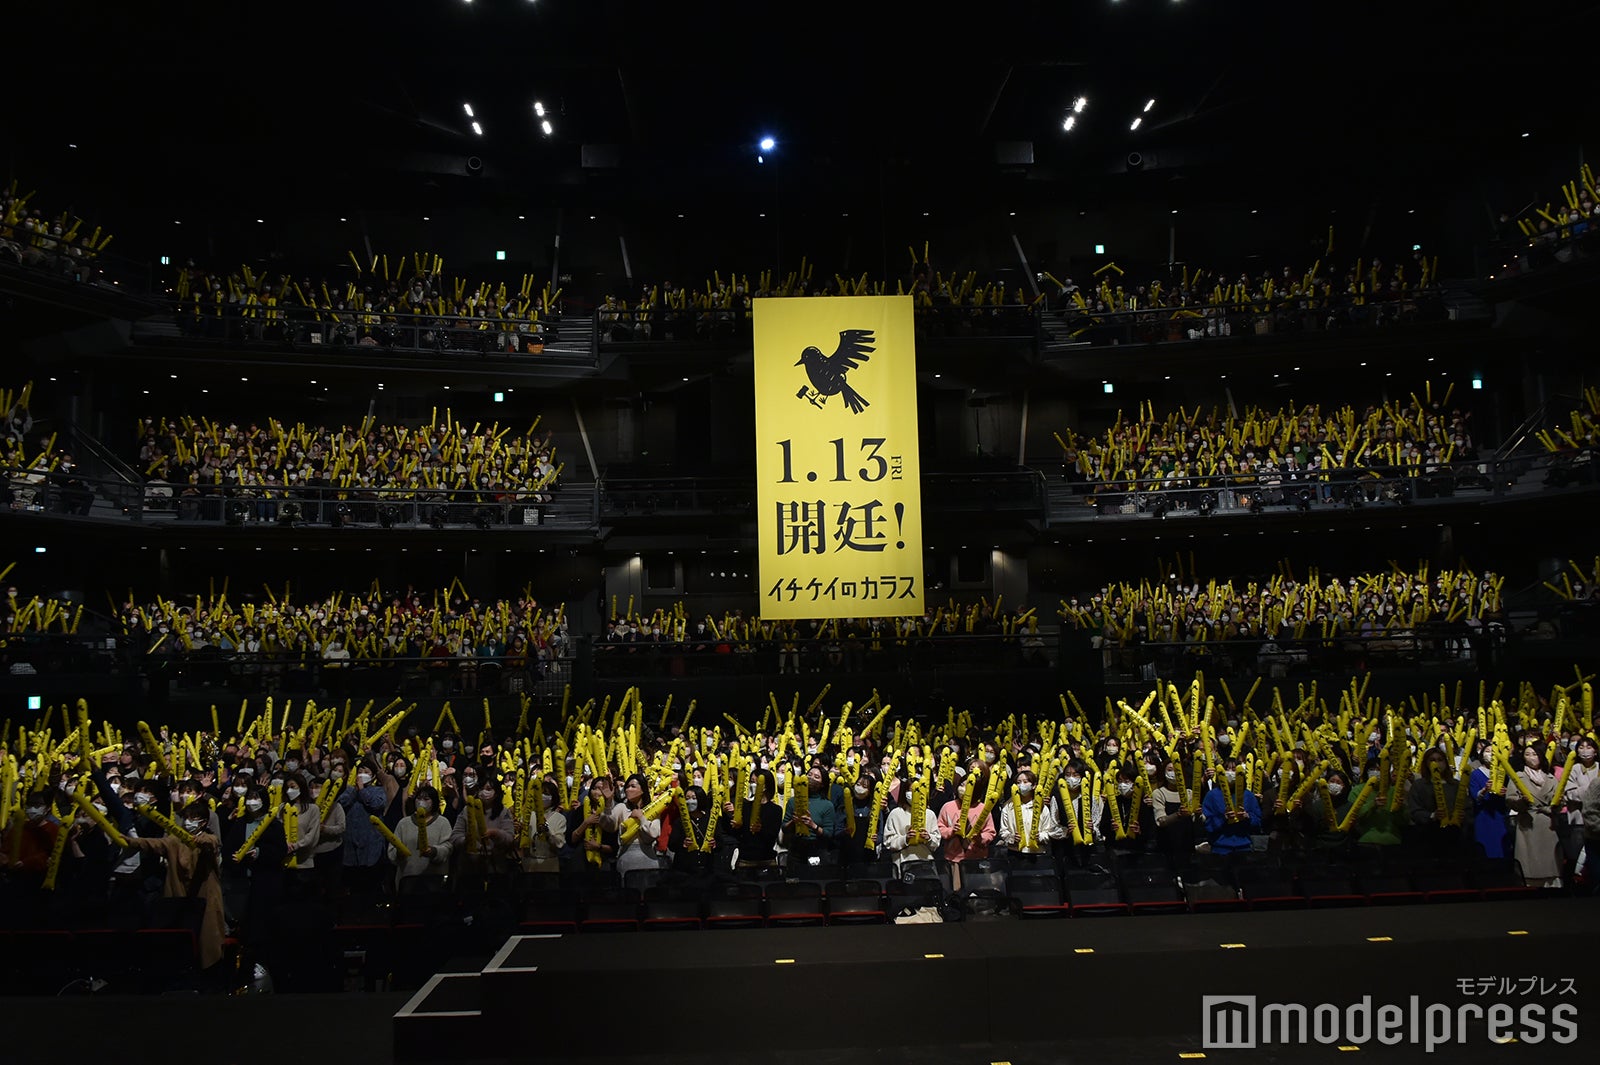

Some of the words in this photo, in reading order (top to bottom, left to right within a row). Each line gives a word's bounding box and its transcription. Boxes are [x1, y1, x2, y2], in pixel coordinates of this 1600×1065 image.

[776, 437, 888, 484] 1.13
[890, 455, 903, 481] FRI
[768, 575, 917, 602] イチケイのカラス
